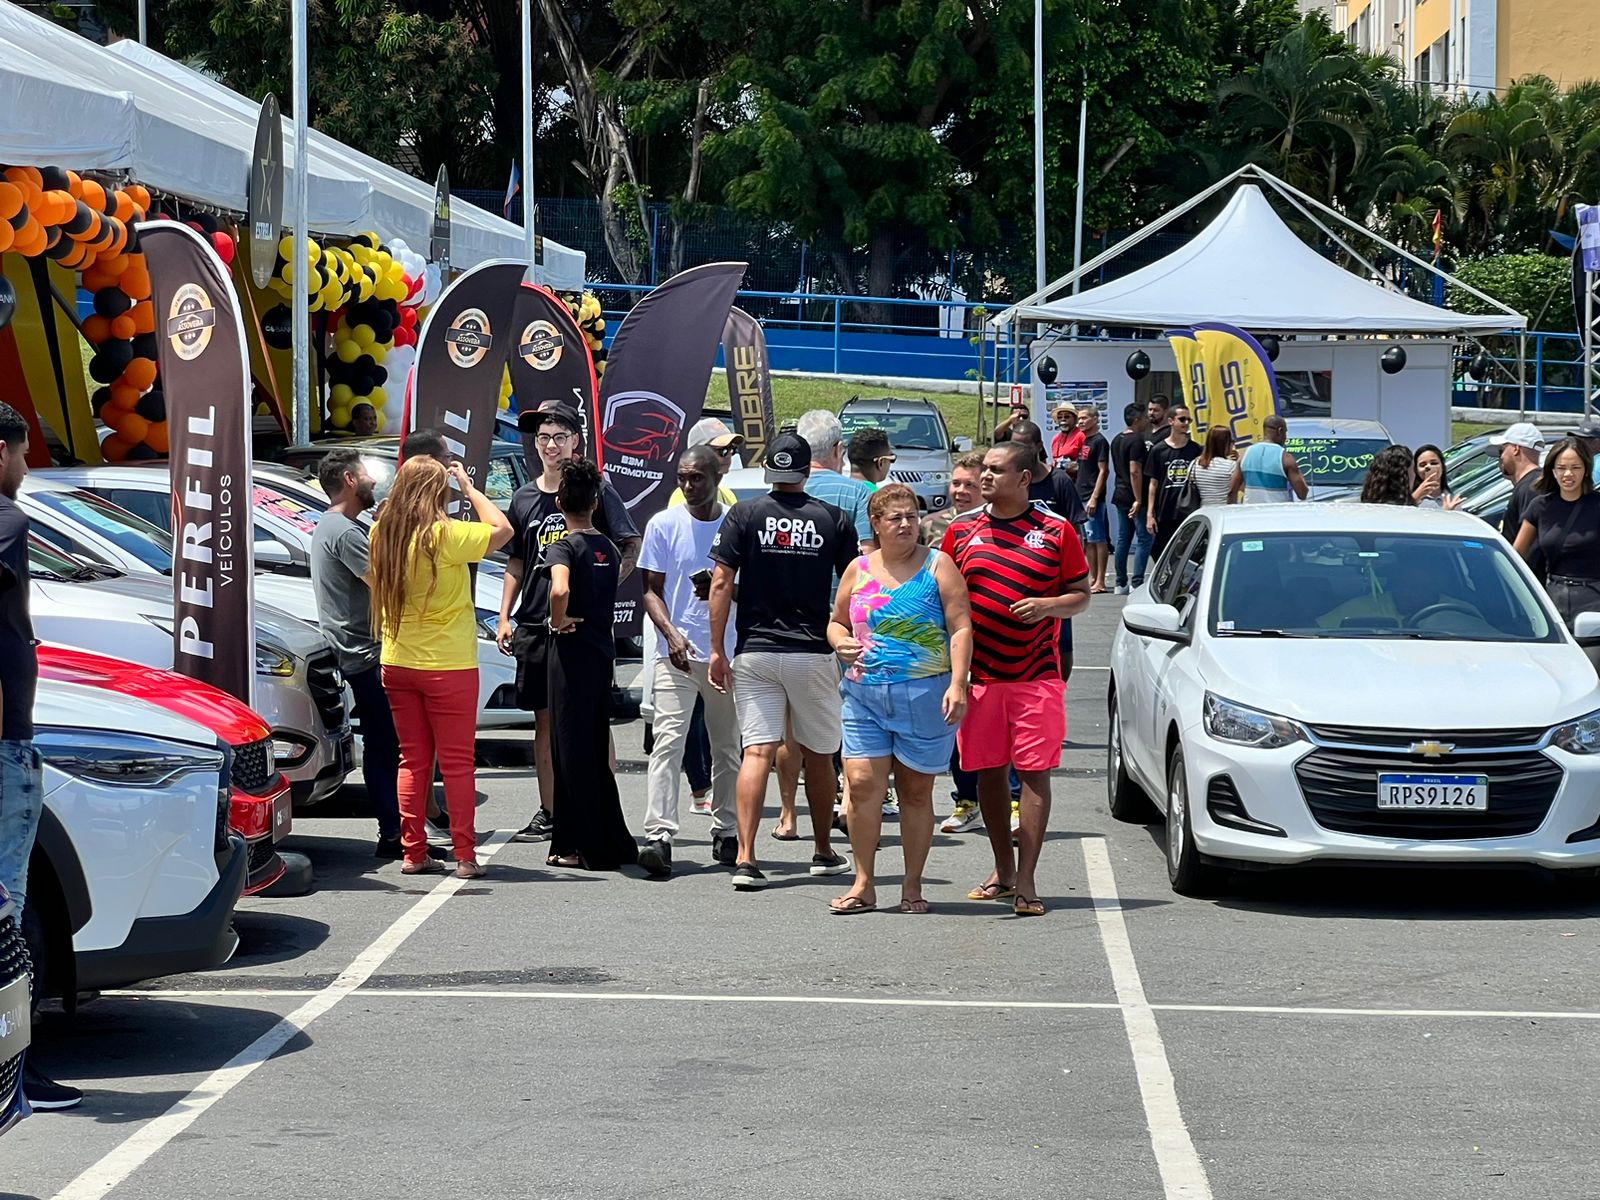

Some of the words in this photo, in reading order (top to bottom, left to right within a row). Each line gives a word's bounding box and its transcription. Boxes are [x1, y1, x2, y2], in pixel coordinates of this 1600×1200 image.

[733, 345, 767, 468] NOBRE
[180, 405, 216, 661] PERFIL
[220, 474, 234, 588] VEÍCULOS
[757, 530, 825, 549] WORLD
[766, 516, 817, 534] BORA
[1389, 786, 1476, 806] RPS9I26
